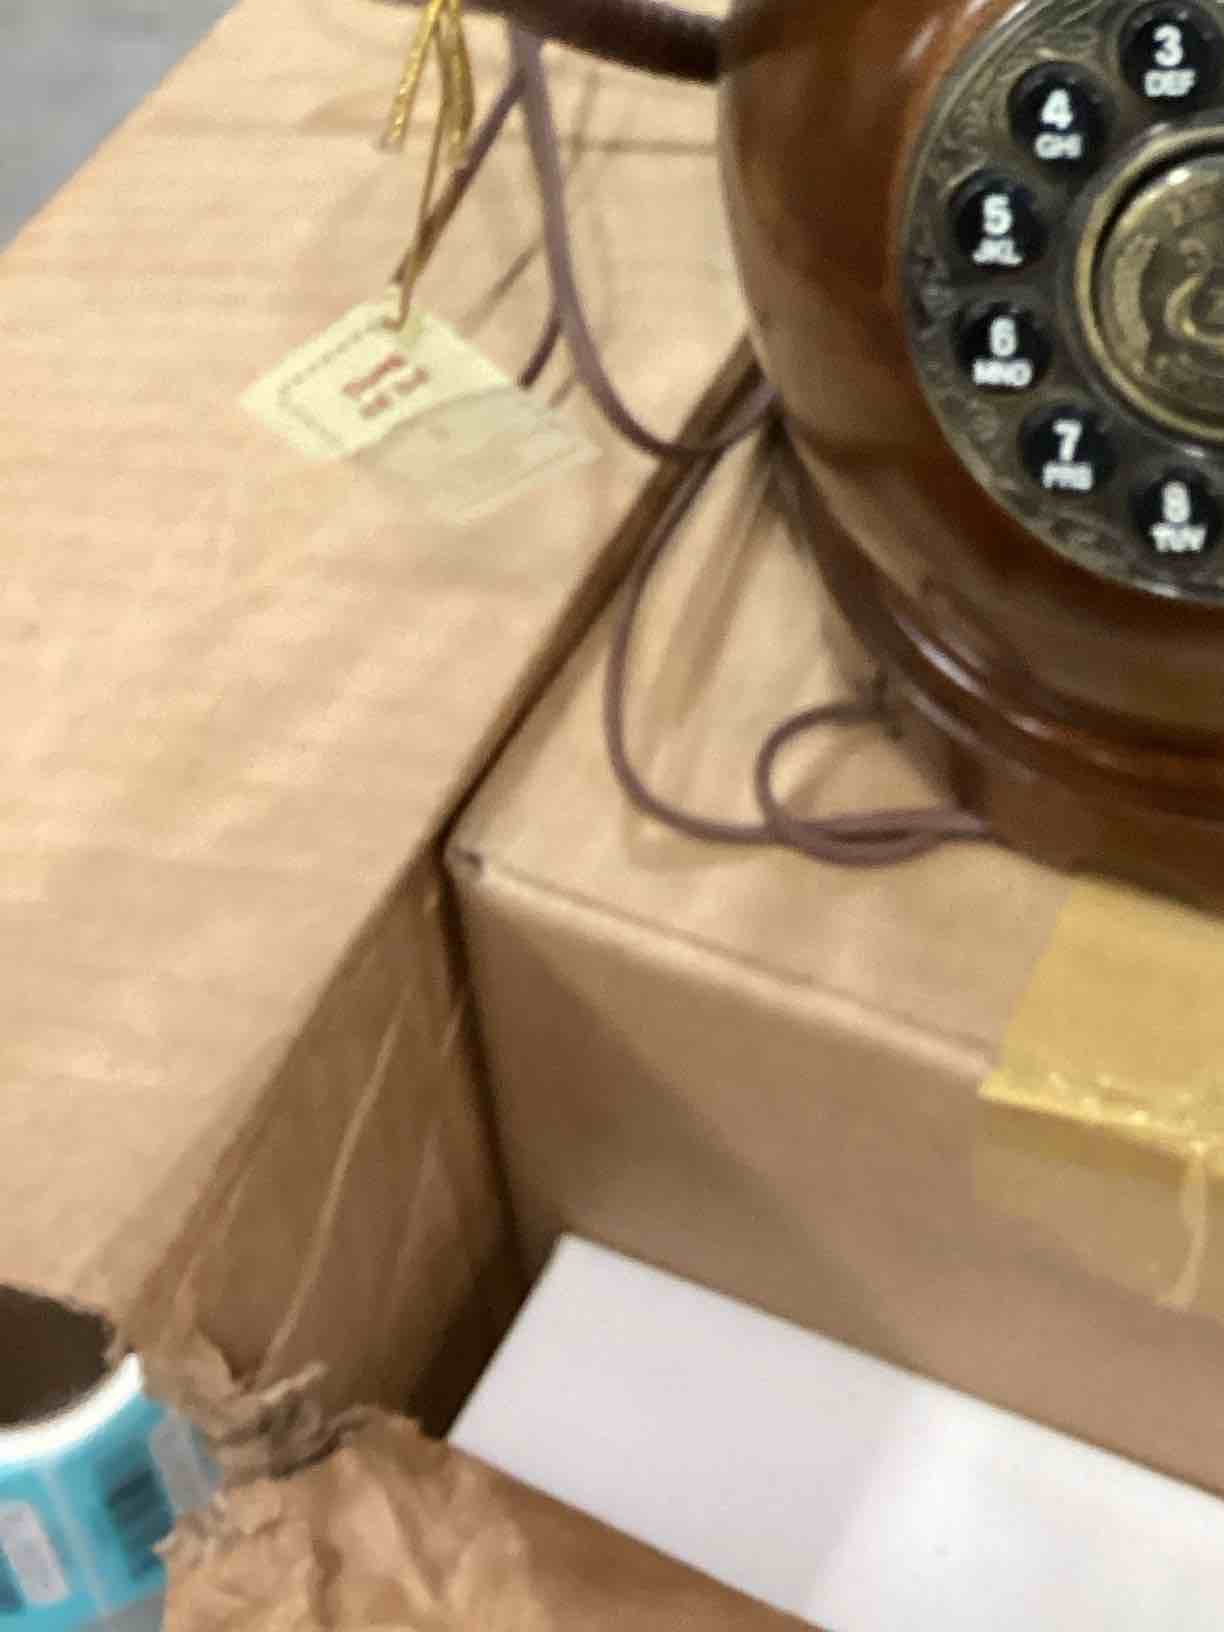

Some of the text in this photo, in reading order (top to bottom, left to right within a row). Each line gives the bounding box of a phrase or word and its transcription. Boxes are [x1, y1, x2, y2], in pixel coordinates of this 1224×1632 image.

[1153, 24, 1184, 67] 3
[1041, 88, 1073, 129] 4
[982, 194, 1013, 236] 5
[990, 317, 1017, 357] 6
[1053, 419, 1082, 462] 7
[1162, 480, 1190, 523] 8
